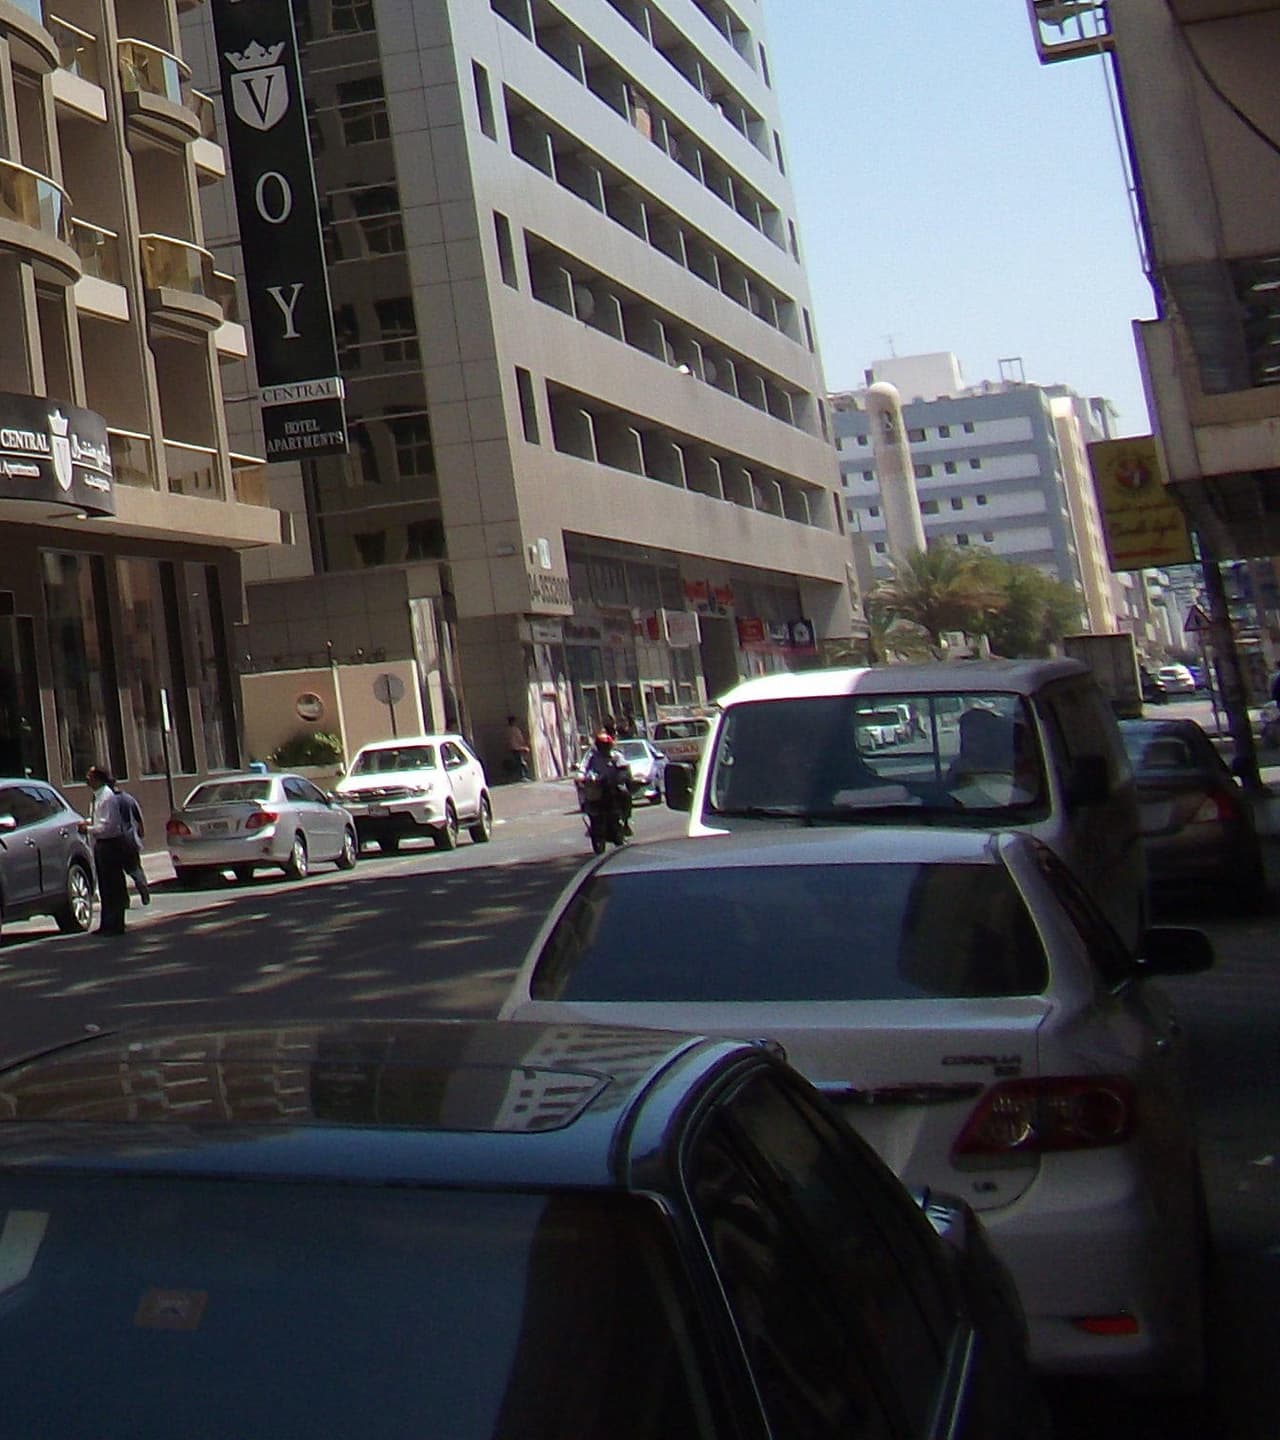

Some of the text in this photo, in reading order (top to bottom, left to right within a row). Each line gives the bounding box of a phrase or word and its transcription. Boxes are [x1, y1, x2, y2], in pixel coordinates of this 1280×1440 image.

[262, 382, 331, 402] CENTRAL
[284, 419, 319, 434] HOTEL
[0, 428, 50, 452] CENTRAL
[267, 430, 344, 453] APARTMENTS
